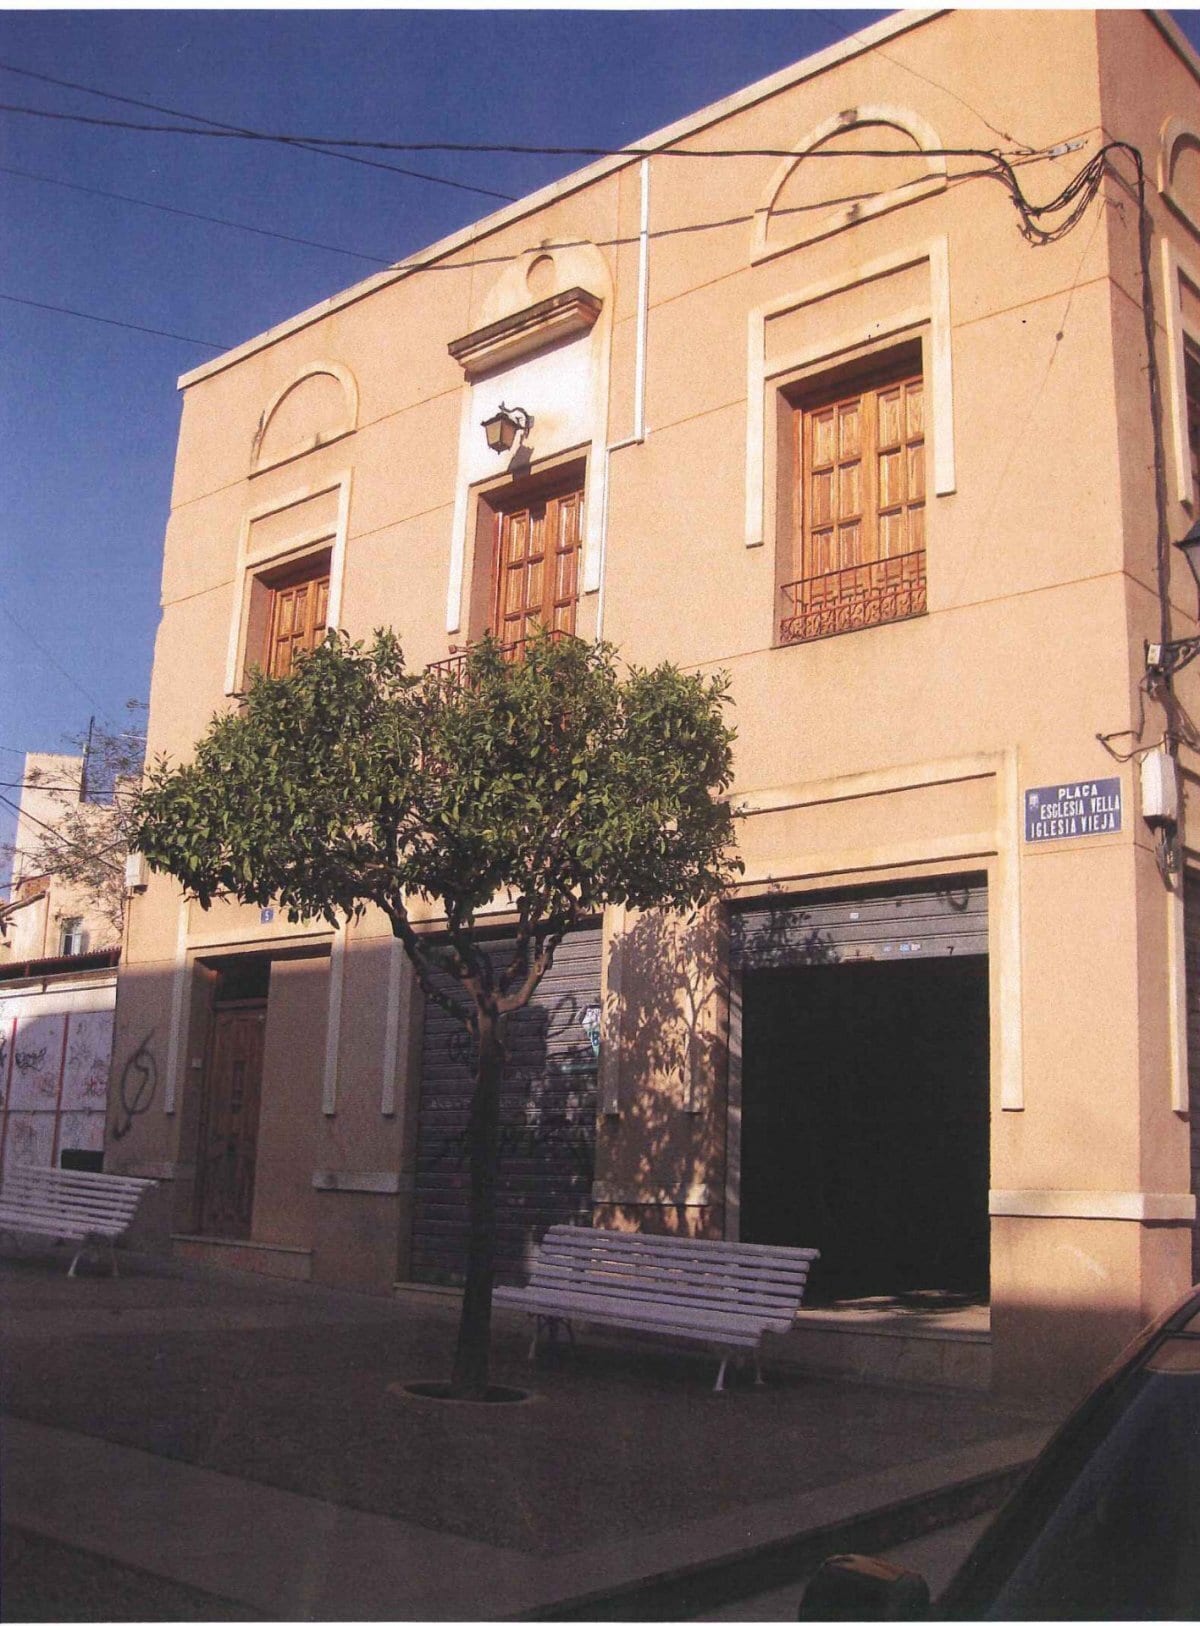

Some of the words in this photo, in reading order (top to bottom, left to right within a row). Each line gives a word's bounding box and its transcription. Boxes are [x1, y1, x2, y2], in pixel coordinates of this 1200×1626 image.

[1040, 799, 1085, 820] ESGLESIA
[1090, 794, 1120, 814] VELLA
[1031, 818, 1077, 839] IGLESIA
[1081, 812, 1115, 833] VIEJA
